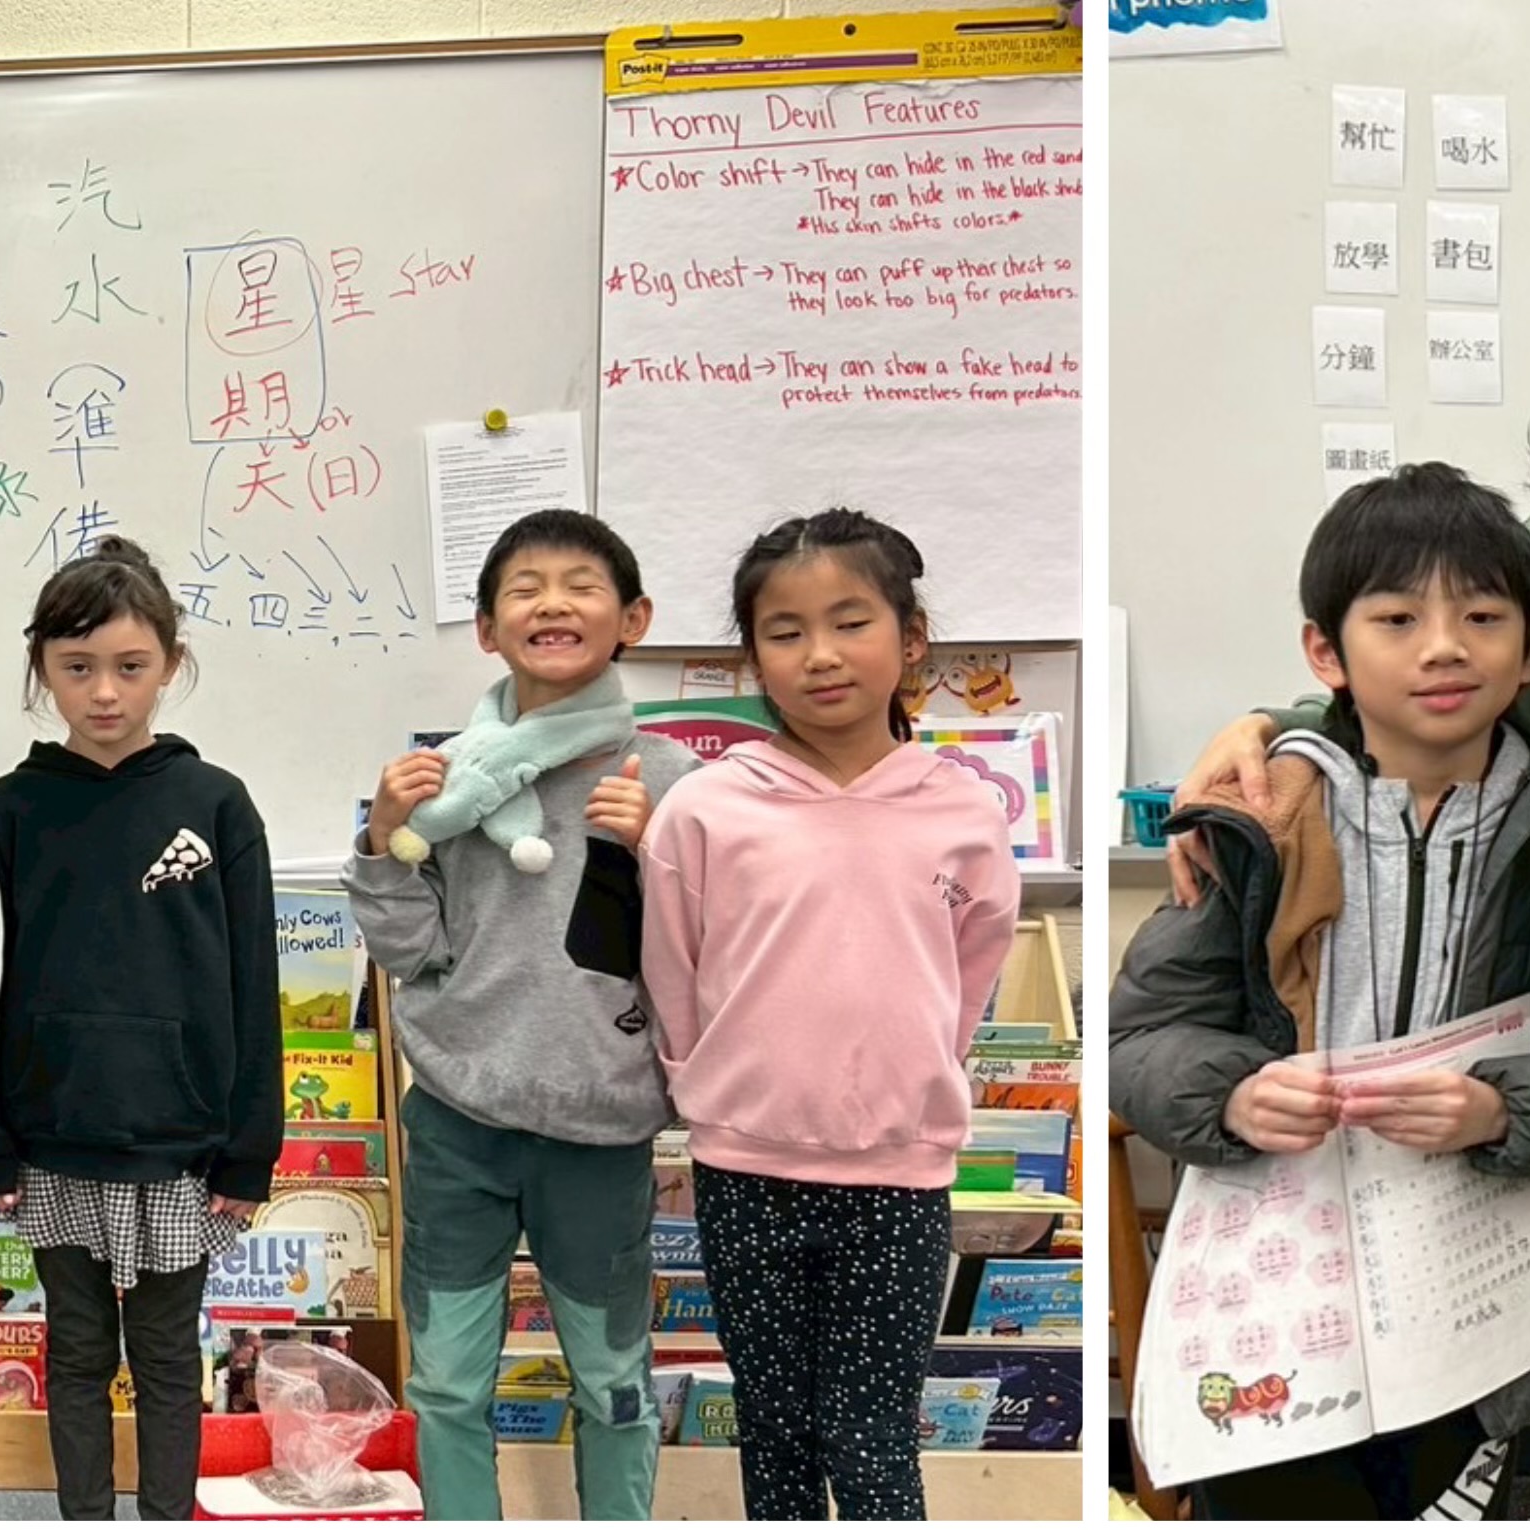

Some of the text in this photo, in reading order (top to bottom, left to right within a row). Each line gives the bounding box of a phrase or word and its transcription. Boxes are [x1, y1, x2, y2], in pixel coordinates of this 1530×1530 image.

[623, 62, 664, 75] Post-it
[613, 90, 981, 148] Thorny Devil Features
[1340, 122, 1396, 152] 幫忙
[1441, 137, 1499, 165] 喝水
[637, 158, 787, 192] Color shift
[812, 158, 857, 190] They
[866, 161, 899, 179] can
[904, 151, 947, 177] hide
[956, 153, 974, 172] in
[983, 147, 1014, 168] the
[1022, 144, 1046, 165] red
[814, 176, 1048, 218] They can hide in the black
[845, 218, 882, 234] skin
[889, 212, 942, 232] shifts
[1333, 242, 1389, 270] 放學
[1432, 239, 1493, 270] 書包
[332, 248, 373, 323] 星
[630, 256, 749, 306] Big chest
[780, 262, 827, 293] They
[835, 266, 867, 283] can
[880, 258, 925, 286] puff
[932, 265, 954, 283] up
[1003, 254, 1046, 278] chest
[1054, 258, 1072, 271] so
[787, 291, 826, 316] they
[835, 289, 877, 310] look
[886, 290, 914, 309] too
[925, 286, 958, 319] big
[965, 281, 990, 301] for
[1320, 344, 1376, 372] 分鐘
[1430, 339, 1495, 361] 辦公室
[631, 351, 752, 383] Trick head
[776, 347, 1079, 384] They can show a fake head to
[781, 384, 852, 409] protect
[864, 383, 962, 401] themselves
[969, 383, 1008, 400] from
[1325, 449, 1391, 471] 圖畫紙
[300, 909, 341, 926] Cows
[276, 929, 344, 954] llowed!
[331, 1053, 353, 1065] Kid
[1031, 1062, 1069, 1071] BUNNY
[1028, 1072, 1070, 1081] TROUBLE
[4, 1240, 22, 1250] the
